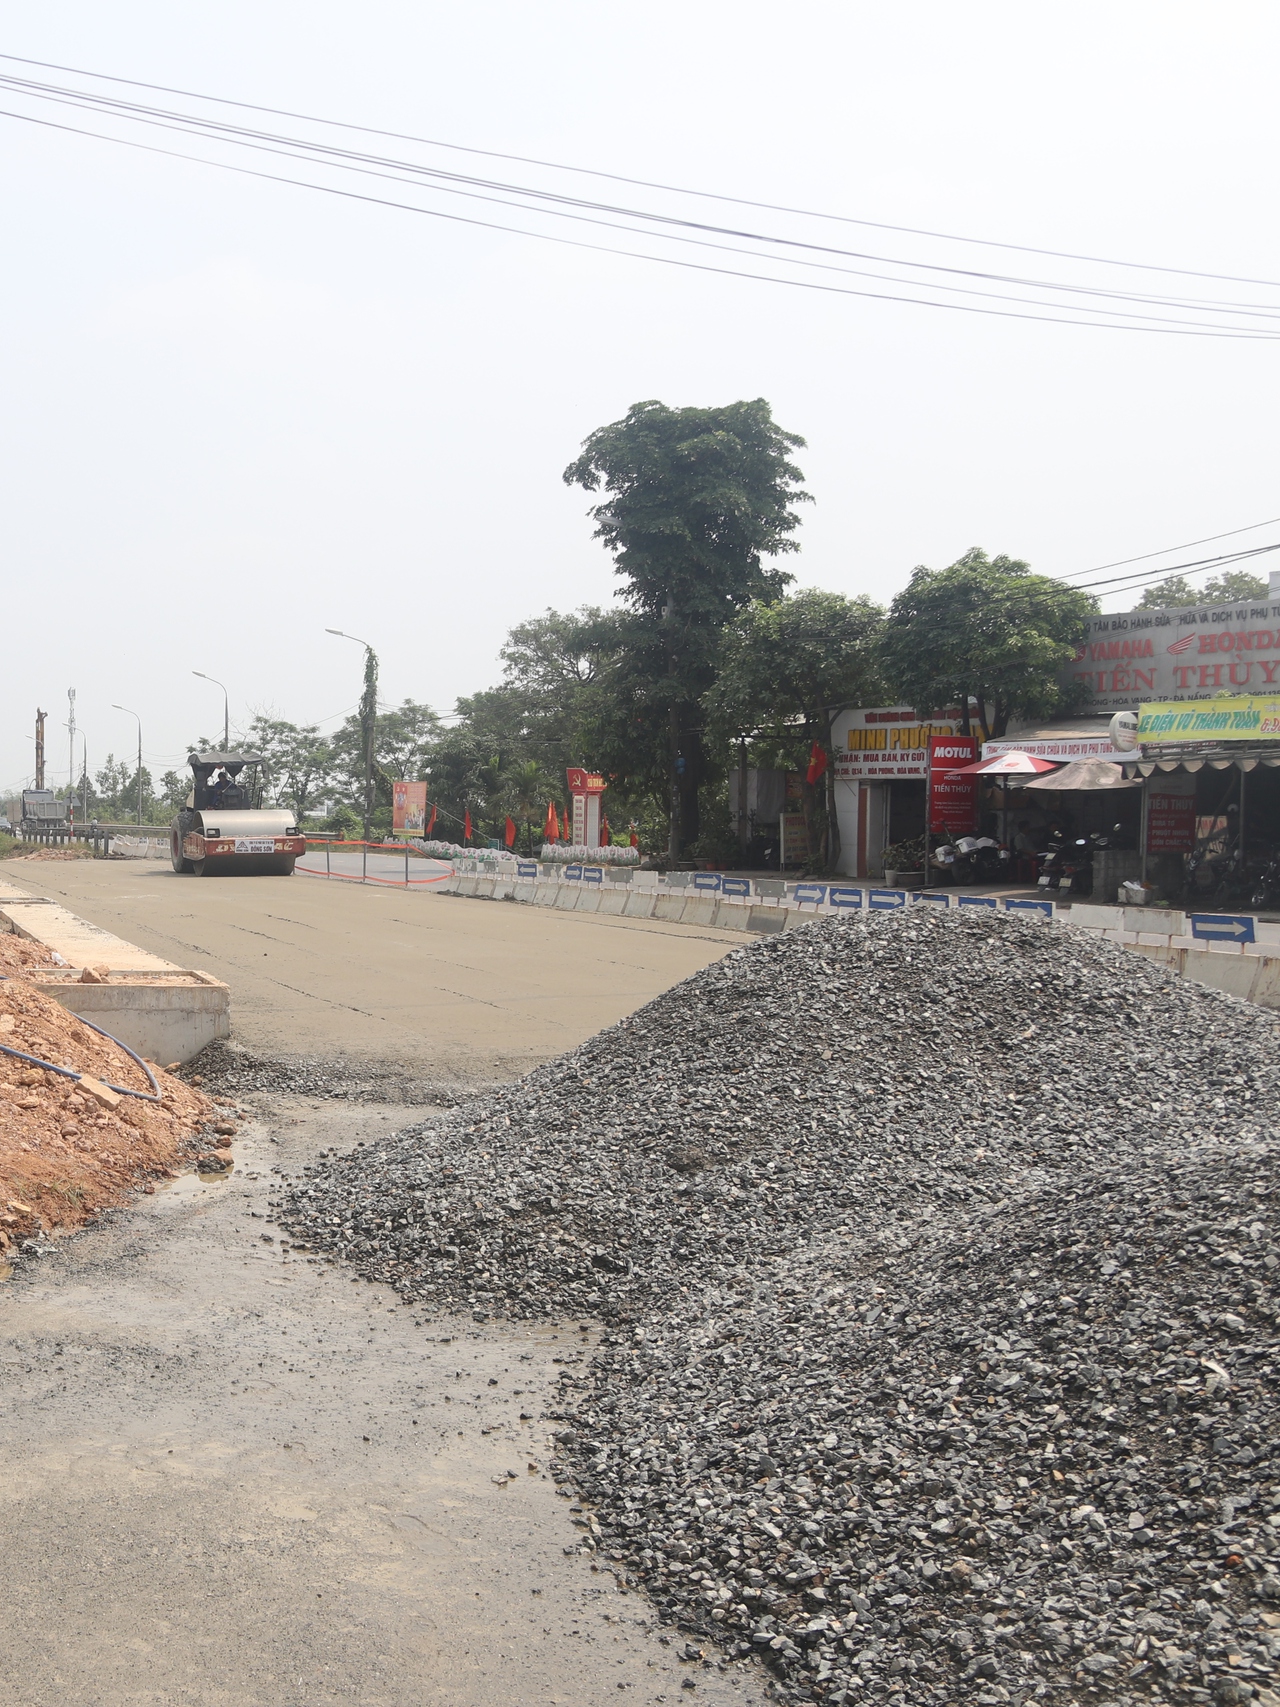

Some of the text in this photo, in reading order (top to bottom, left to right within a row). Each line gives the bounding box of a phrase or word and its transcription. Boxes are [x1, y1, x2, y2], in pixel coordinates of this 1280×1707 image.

[1093, 620, 1109, 633] TÂM
[1112, 617, 1128, 631] BẢO
[1131, 616, 1152, 629] HÀNH
[1179, 611, 1197, 625] HỮA
[1211, 610, 1232, 624] DỊCH
[1235, 608, 1248, 622] VỤ
[1250, 606, 1269, 620] PHỤ
[1089, 638, 1155, 662] YAMAHA
[848, 728, 887, 750] MINH
[863, 753, 879, 762] MUA
[934, 746, 972, 758] MOTUL
[934, 782, 950, 793] TIẾN
